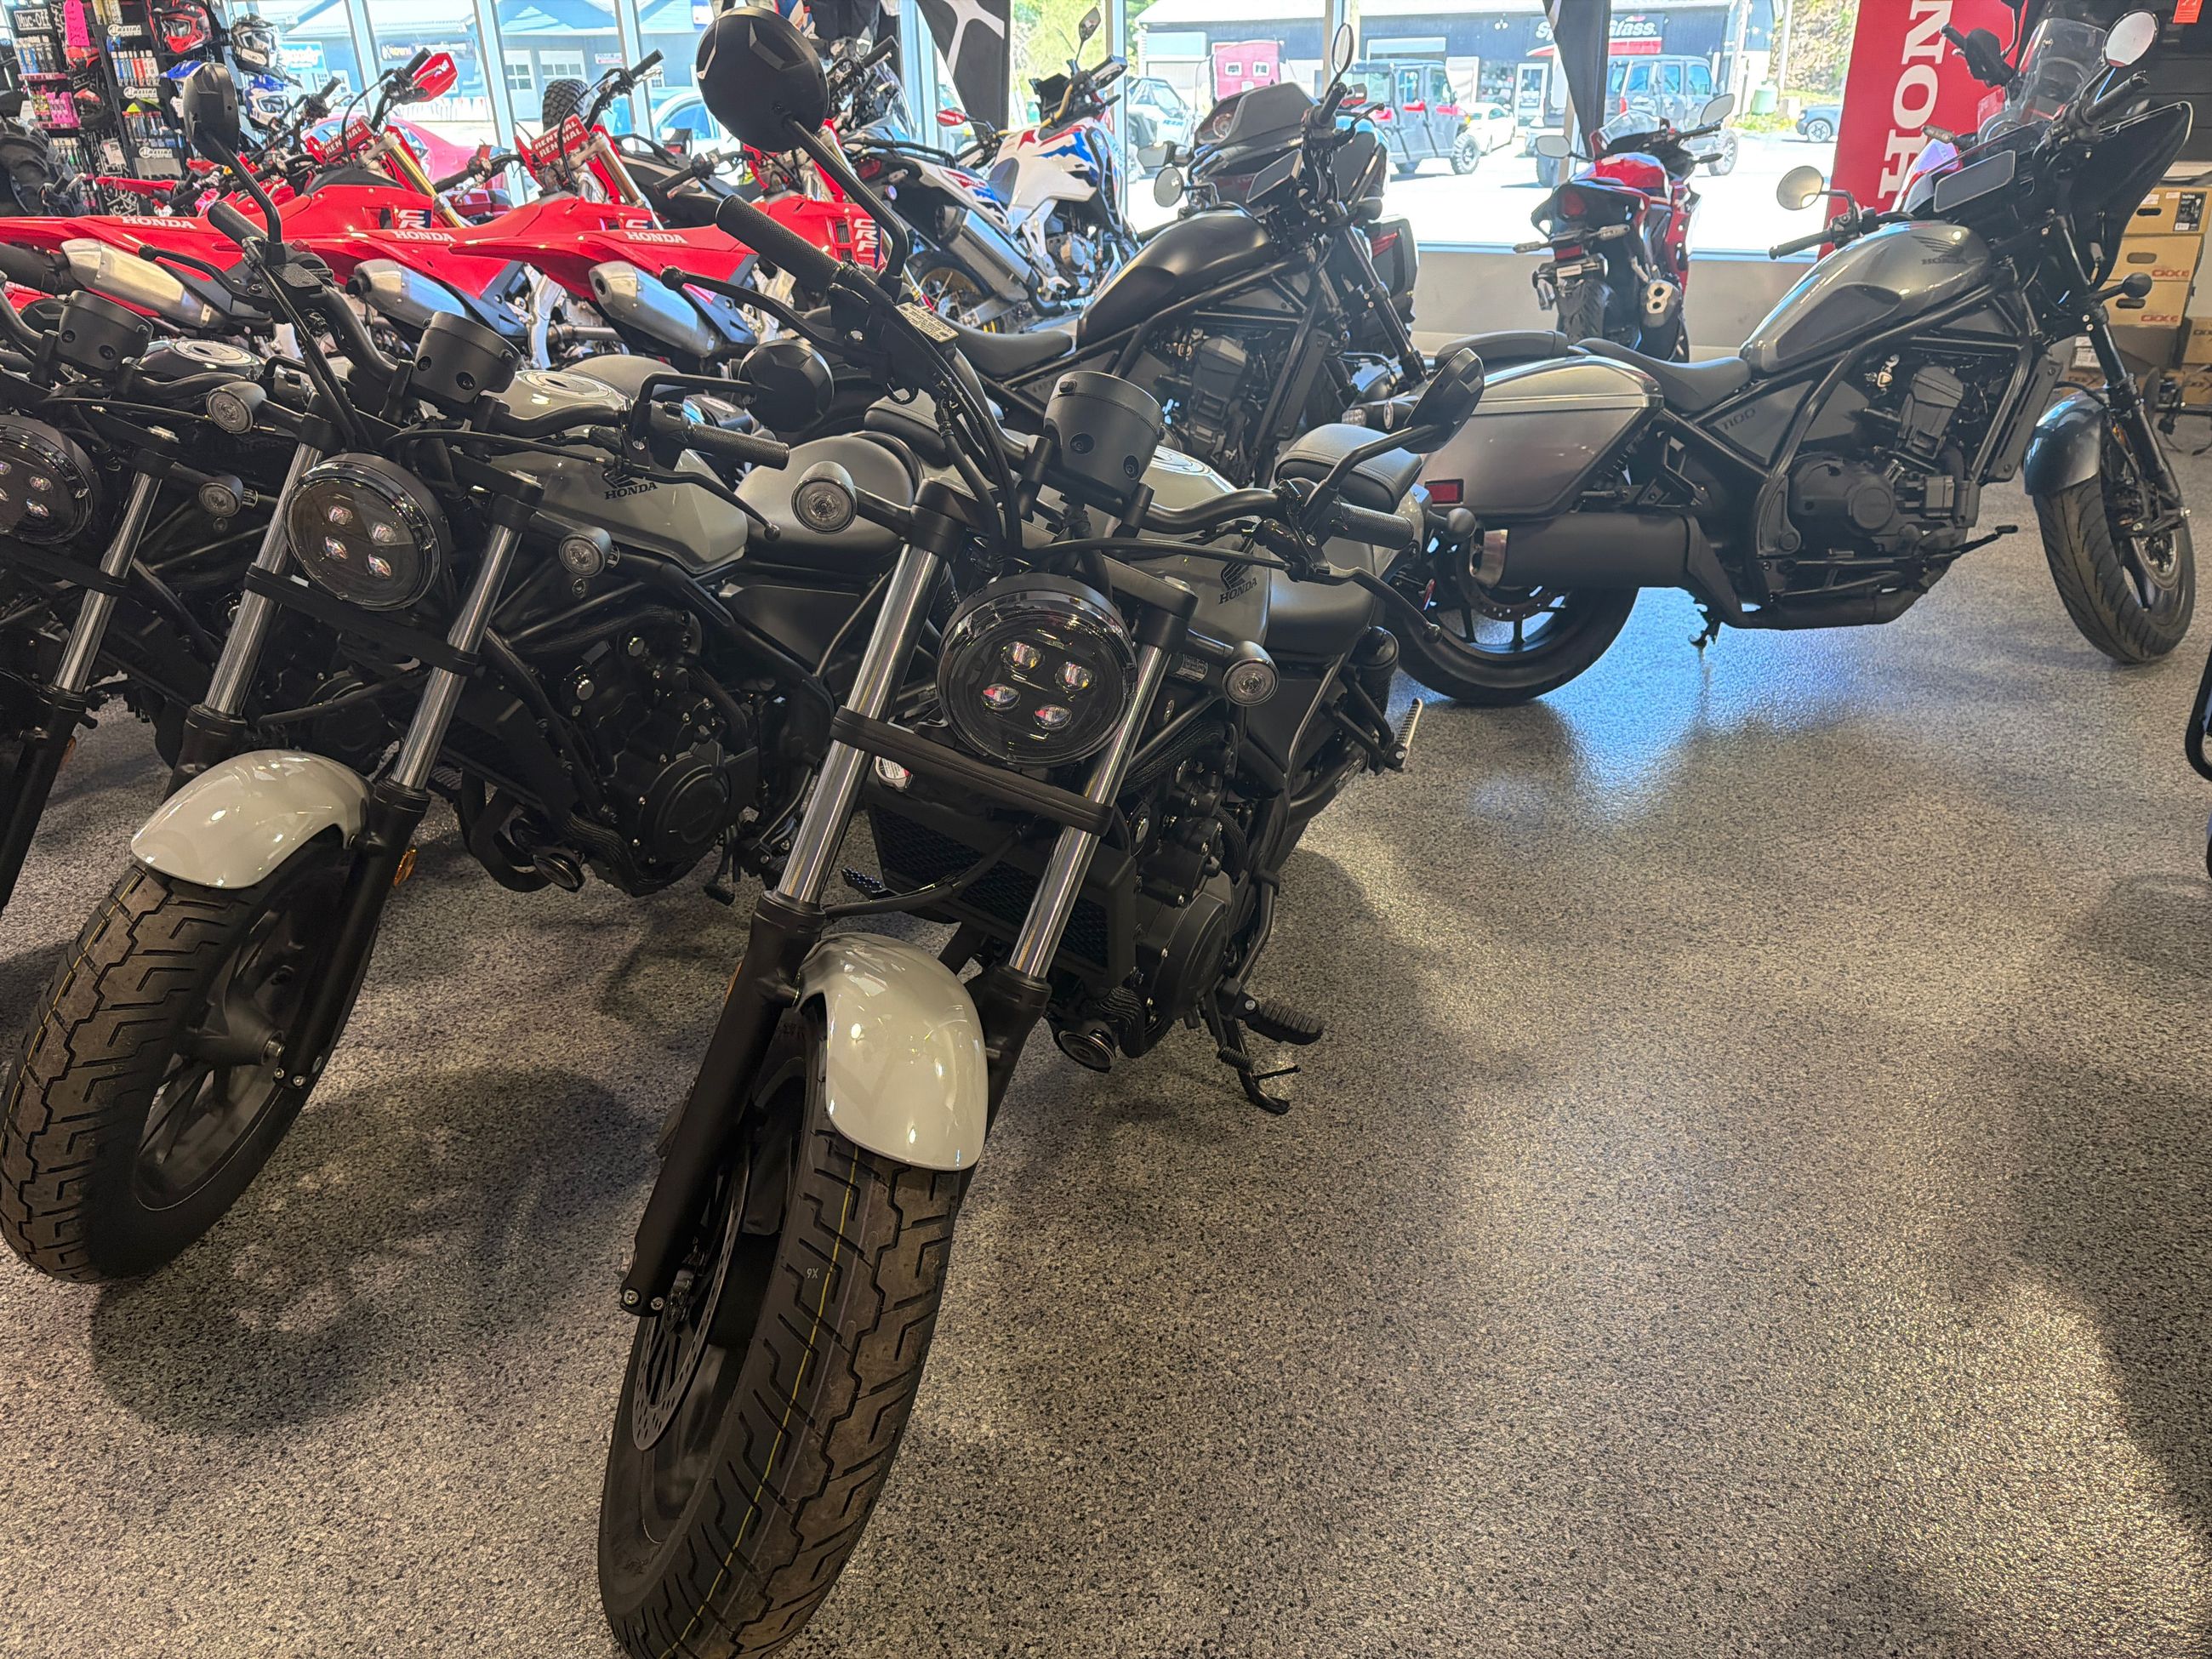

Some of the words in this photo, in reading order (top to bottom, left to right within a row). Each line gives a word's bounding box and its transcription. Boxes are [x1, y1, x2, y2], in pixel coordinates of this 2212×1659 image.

[17, 10, 49, 28] Muc-Off
[325, 125, 364, 155] RENHAL
[534, 119, 578, 151] RENTAL
[539, 128, 583, 158] RENHAL
[122, 216, 197, 230] HONDA
[391, 231, 458, 242] HONDA
[624, 231, 688, 244] HONDA
[604, 482, 658, 500] HONDA
[1218, 578, 1258, 605] HONDA
